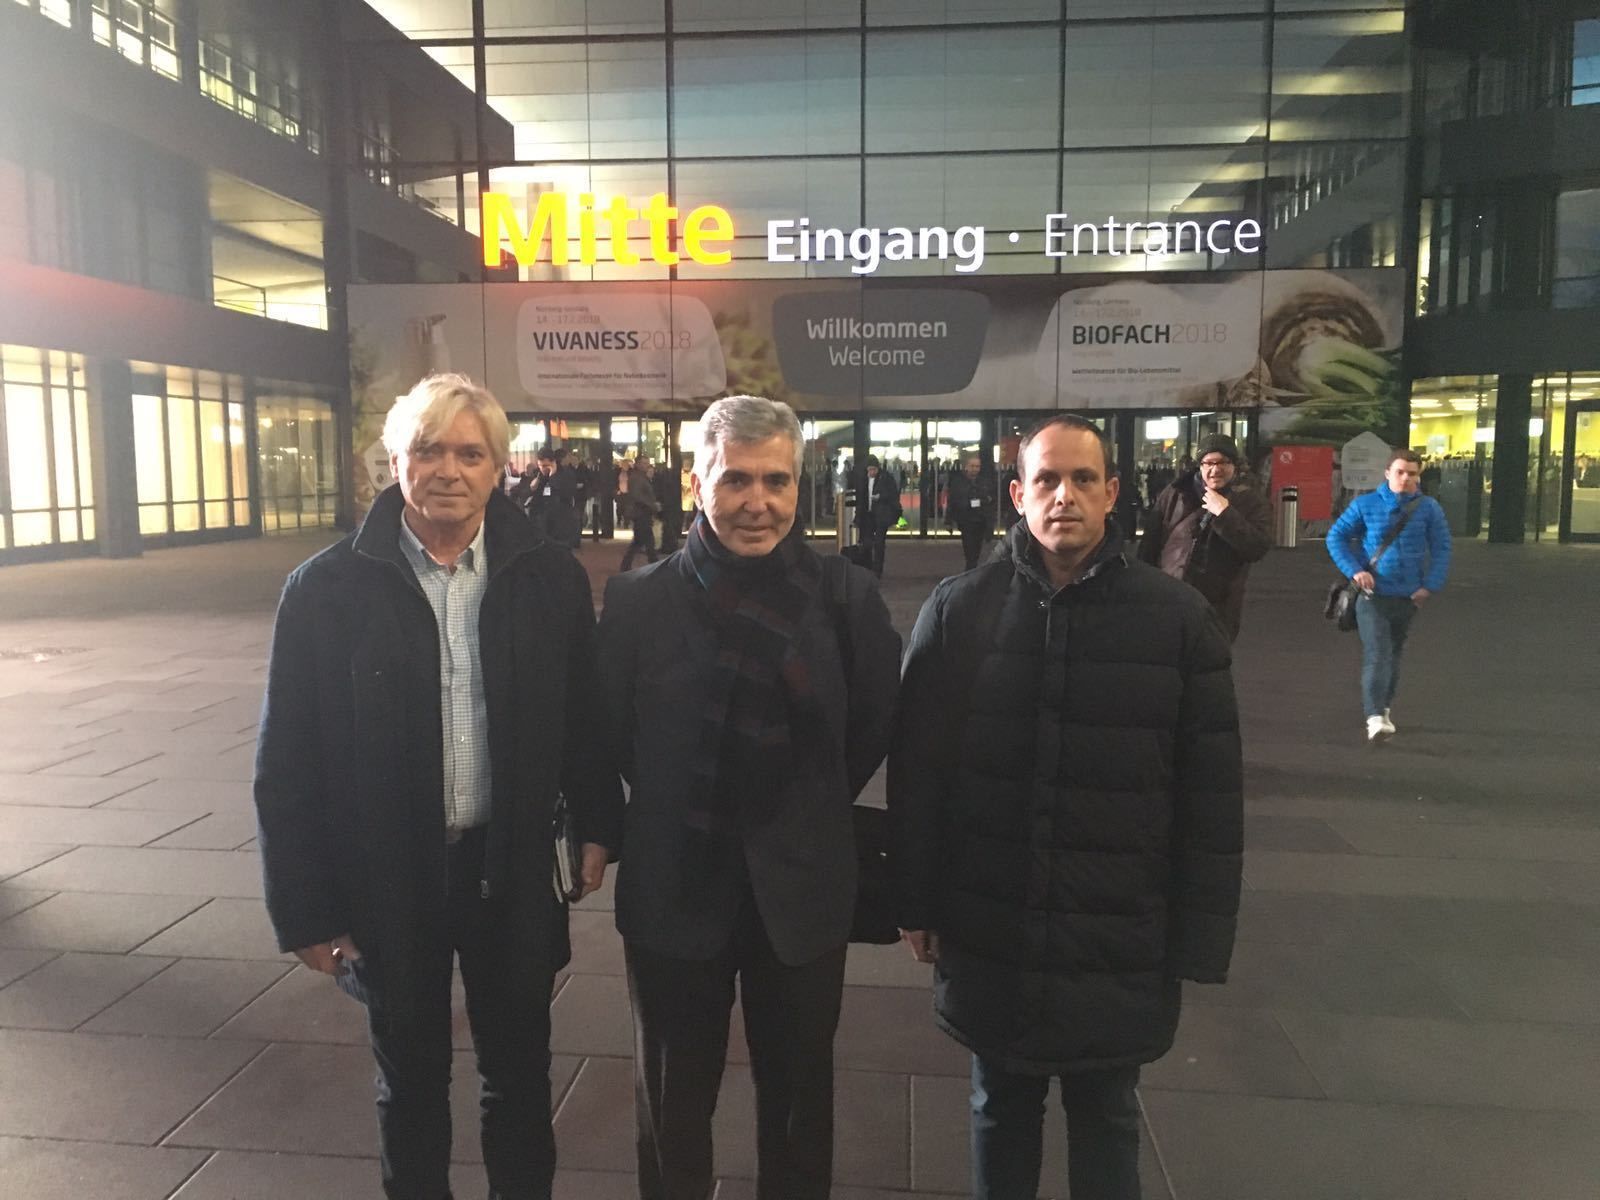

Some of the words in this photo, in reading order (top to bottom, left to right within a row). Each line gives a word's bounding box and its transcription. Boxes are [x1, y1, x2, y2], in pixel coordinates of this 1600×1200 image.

[483, 192, 734, 266] Mitte
[766, 218, 985, 274] Eingang
[1044, 213, 1262, 257] Entrance
[806, 318, 947, 339] Willkommen
[829, 345, 925, 366] Welcome
